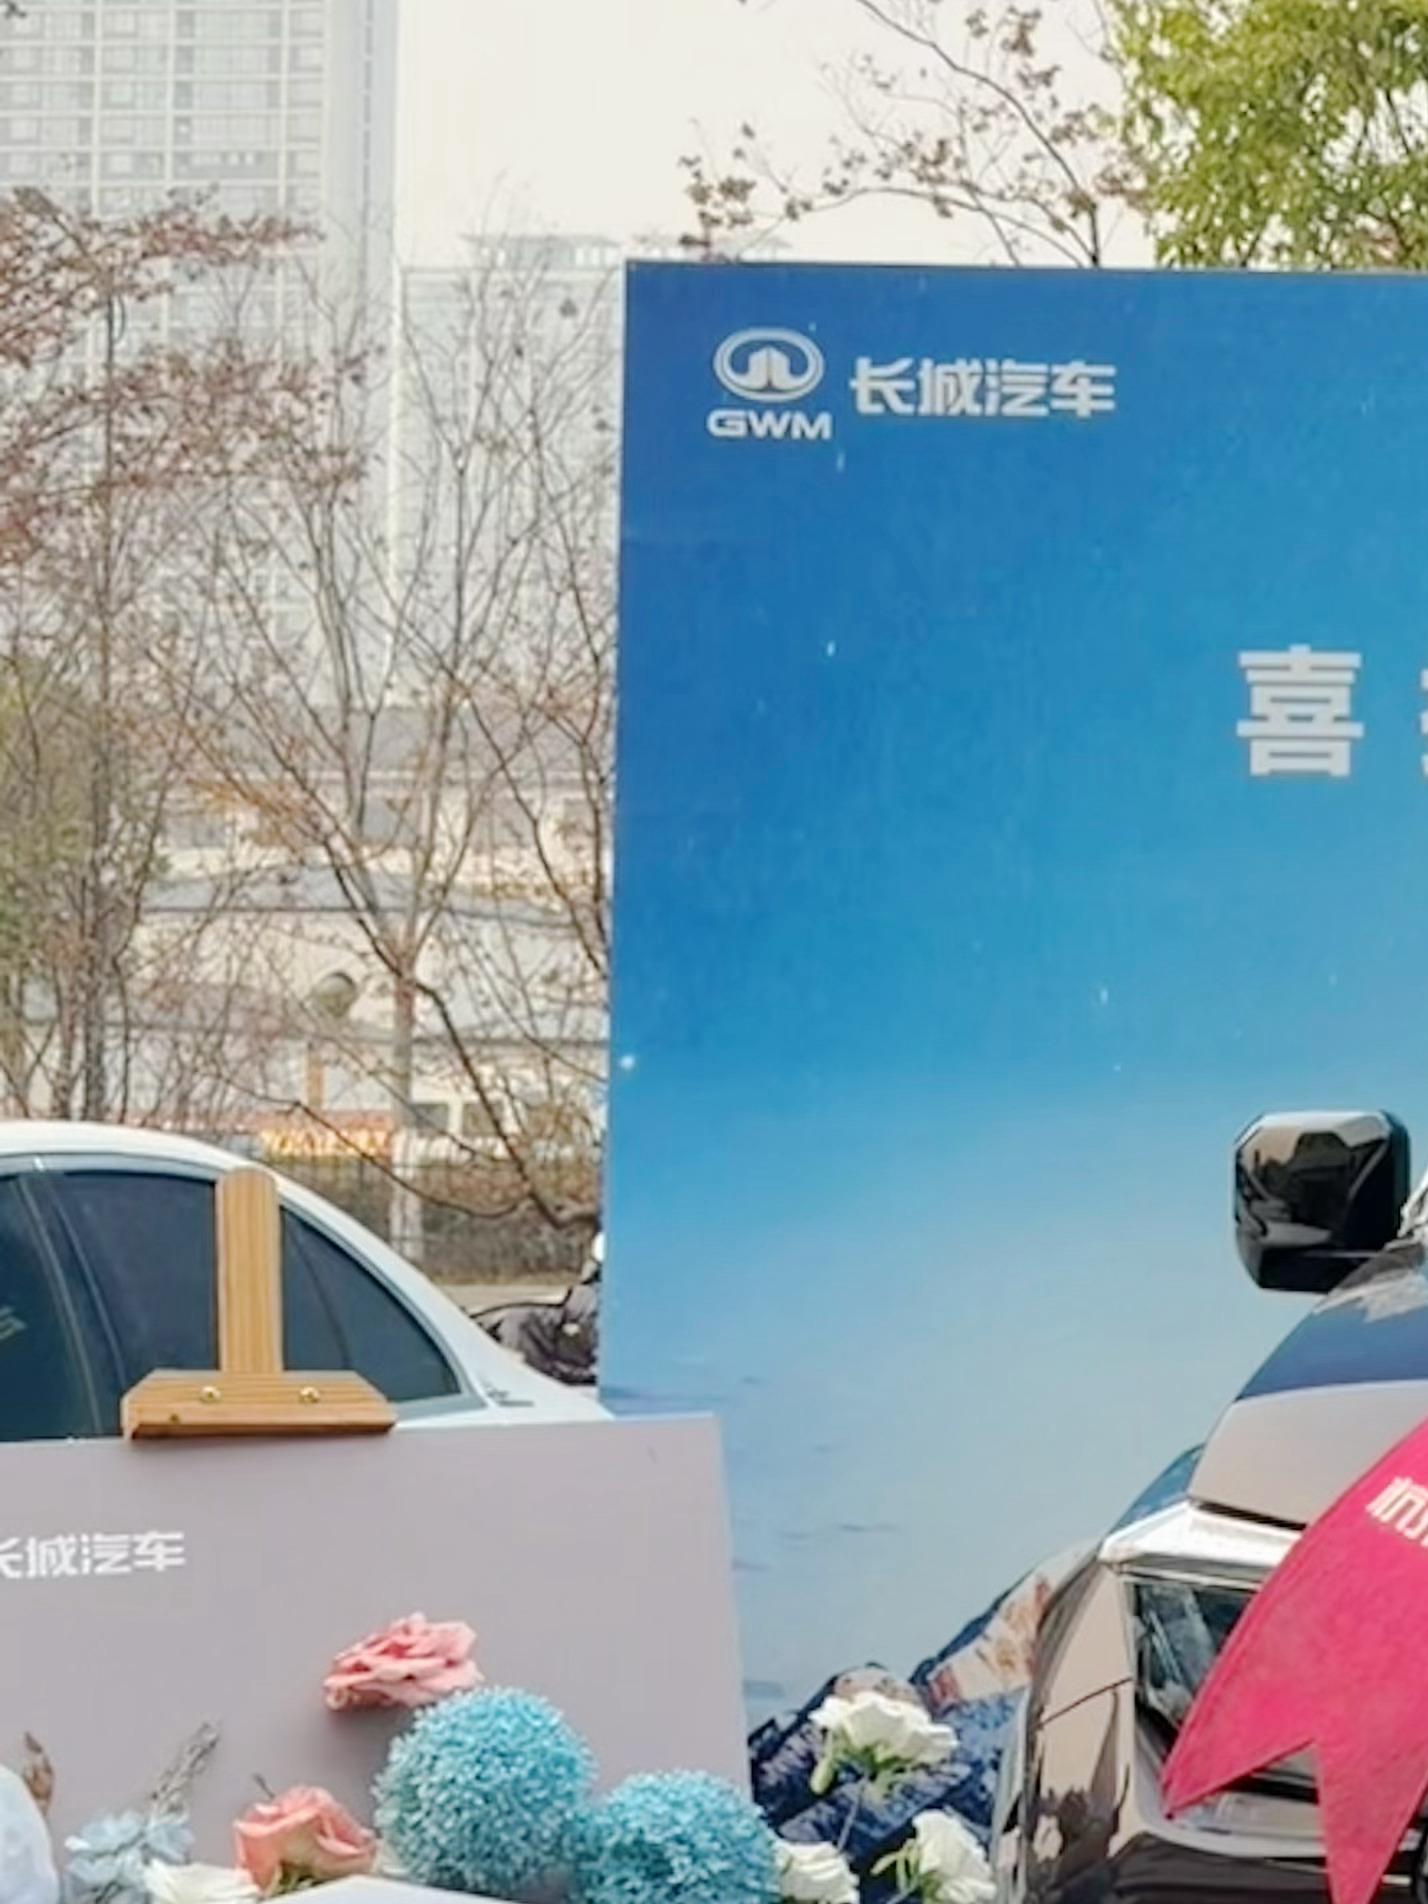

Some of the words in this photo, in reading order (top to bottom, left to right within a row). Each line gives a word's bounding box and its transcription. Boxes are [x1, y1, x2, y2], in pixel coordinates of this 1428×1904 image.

[849, 357, 1117, 418] 长城汽车
[706, 409, 833, 440] GWM
